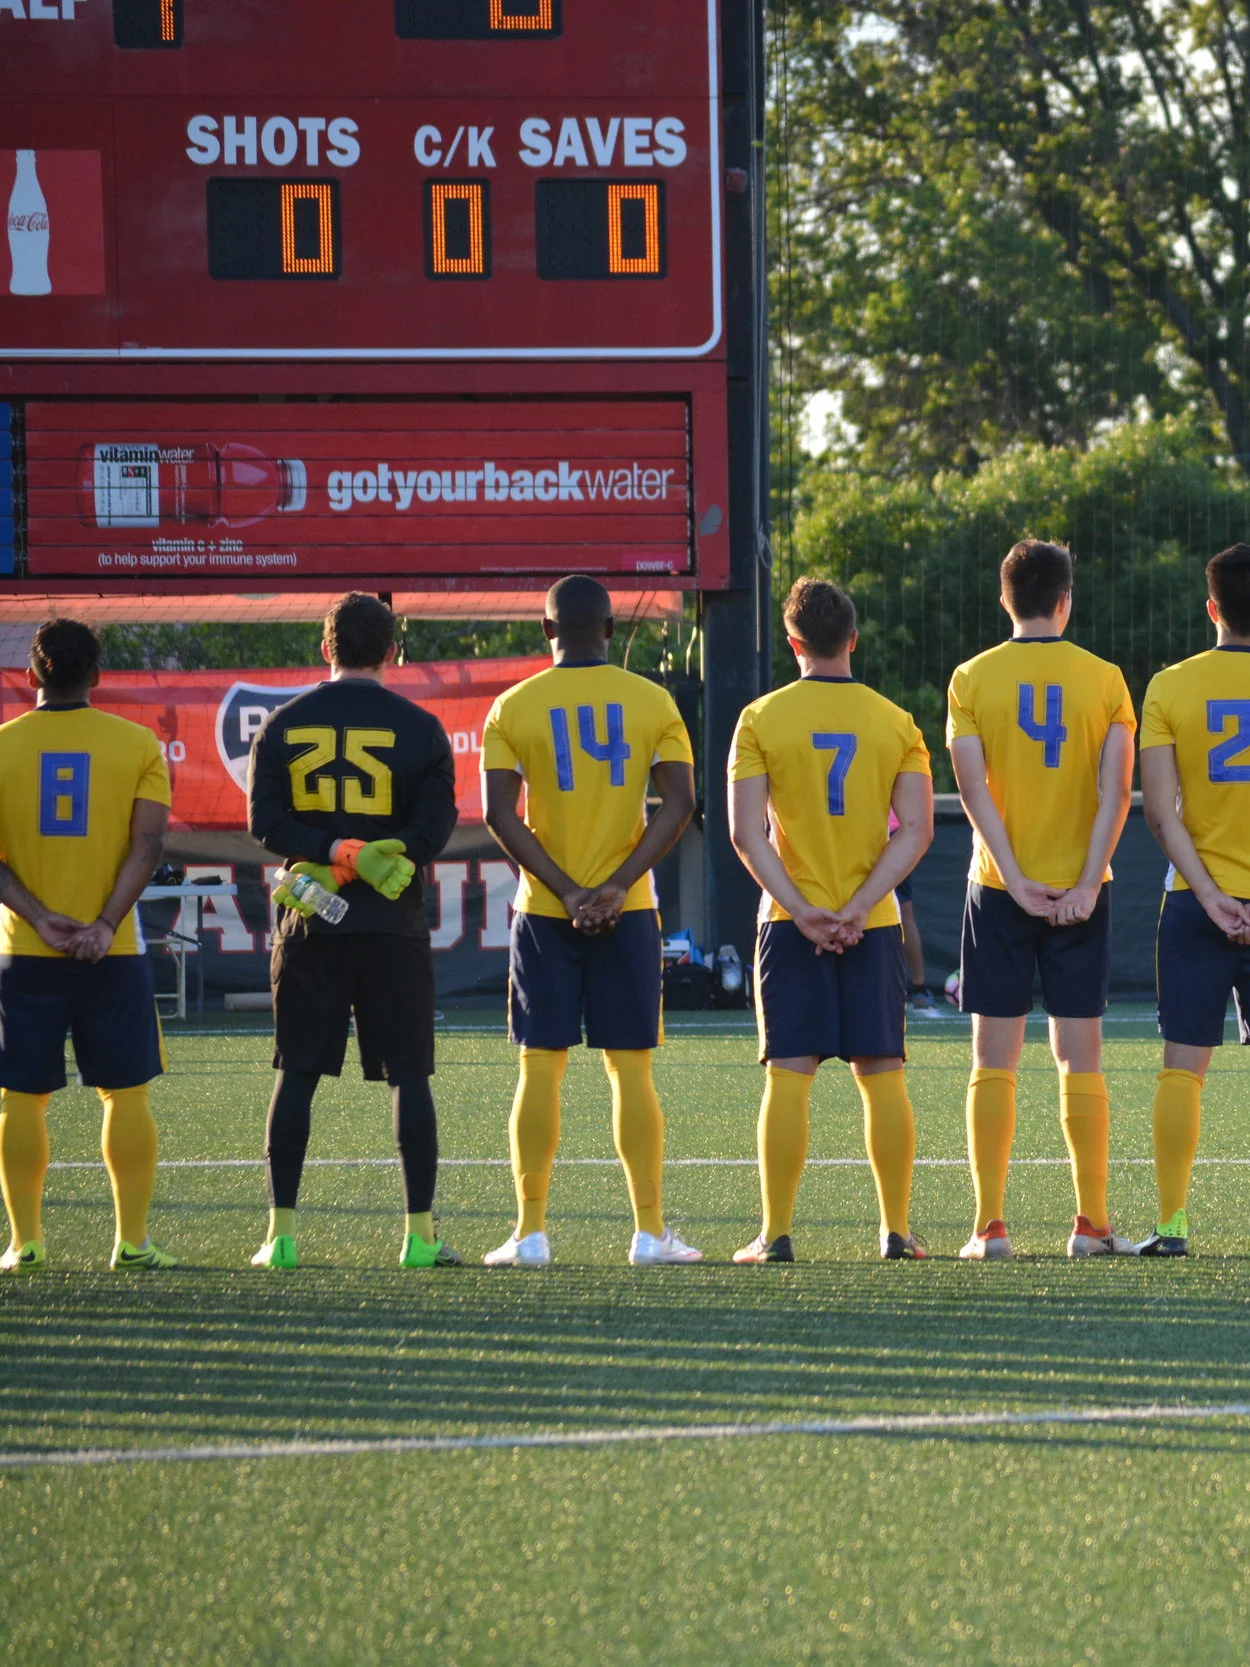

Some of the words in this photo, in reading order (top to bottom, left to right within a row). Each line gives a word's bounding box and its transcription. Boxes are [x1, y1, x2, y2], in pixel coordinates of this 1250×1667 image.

[186, 116, 361, 167] SHOTS
[414, 126, 496, 168] C/K
[518, 117, 688, 167] SAVES
[281, 184, 333, 274] 0
[432, 184, 483, 274] 0
[608, 184, 659, 274] 0
[100, 447, 195, 465] vitaminwater
[327, 462, 675, 511] gotyourbackwater
[98, 553, 112, 567] (to
[114, 553, 137, 567] help
[140, 554, 181, 567] support
[183, 555, 206, 567] your
[209, 553, 253, 565] immune
[255, 553, 297, 567] system)
[152, 538, 195, 552] vitamin
[219, 538, 244, 552] zinc
[549, 703, 631, 791] 14
[1017, 681, 1067, 768] 4
[39, 752, 91, 837] 8
[284, 726, 396, 815] 25
[811, 732, 858, 816] 7
